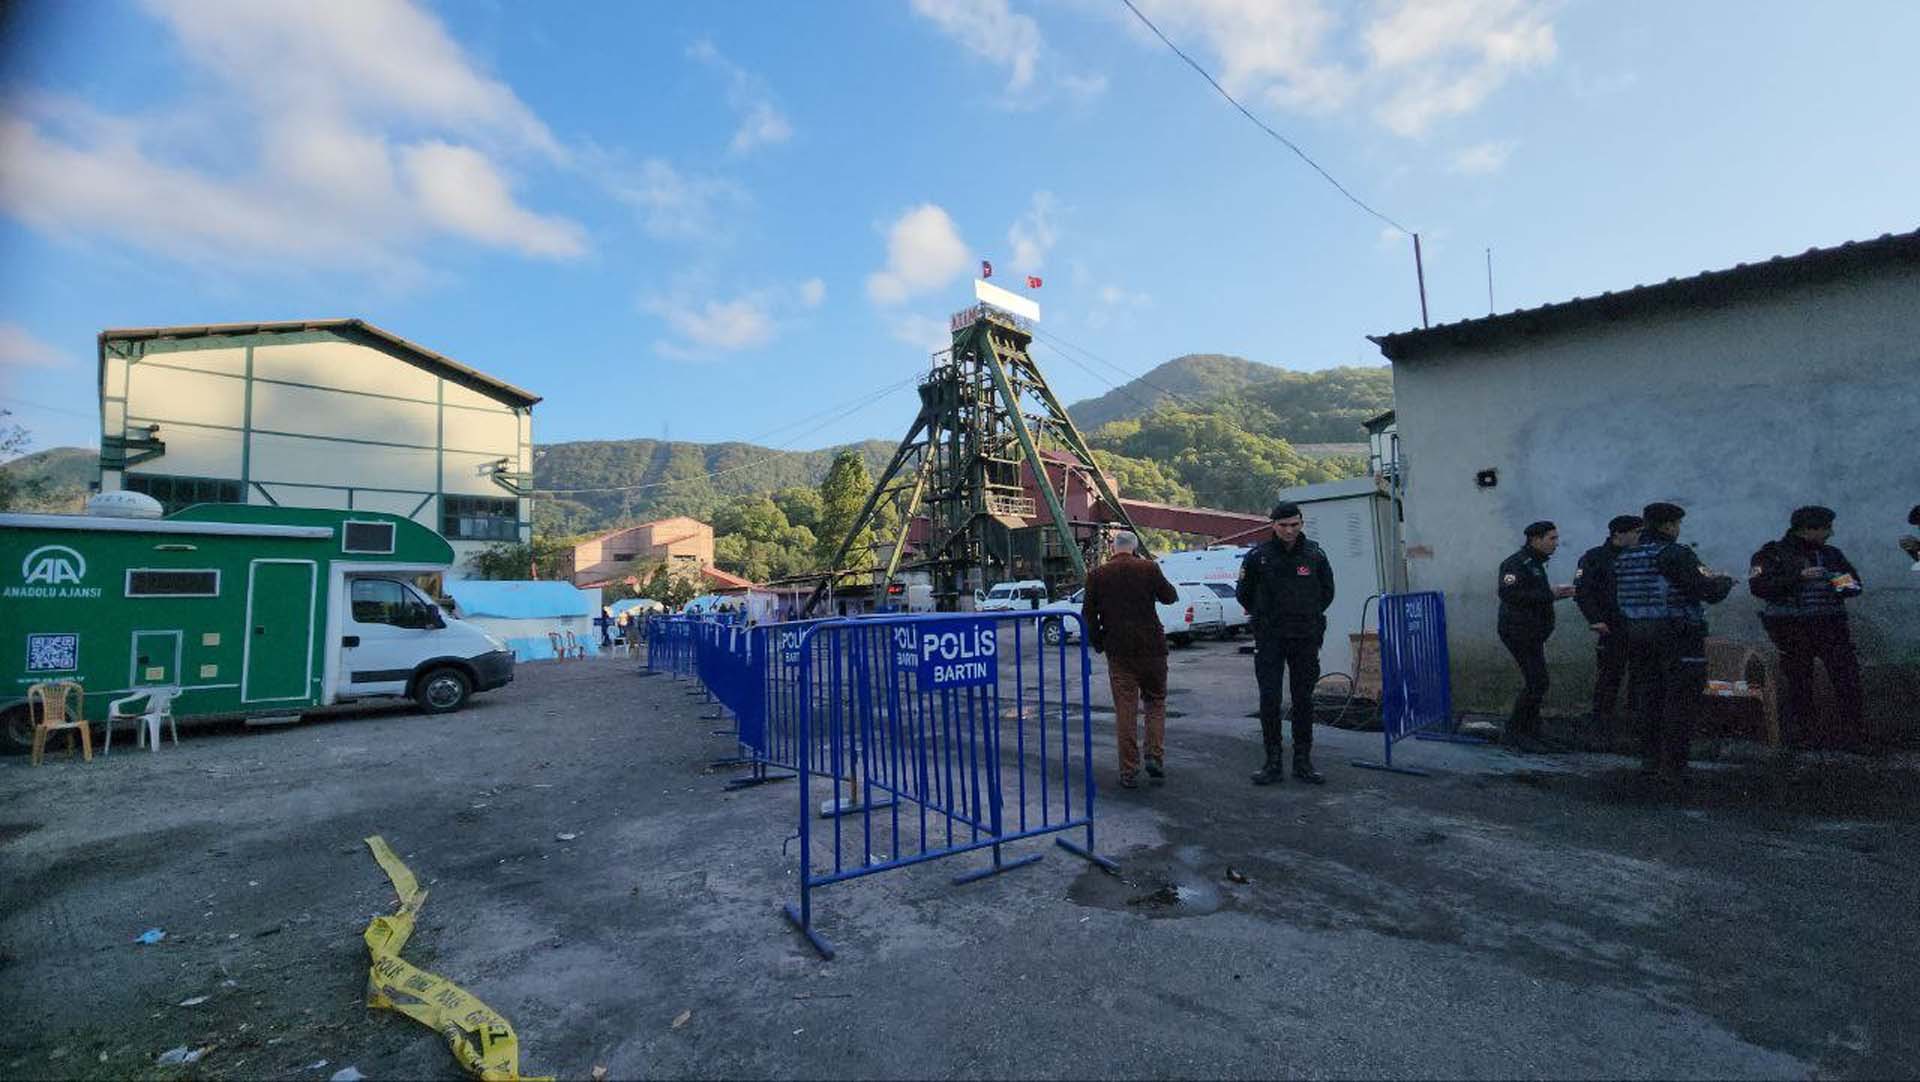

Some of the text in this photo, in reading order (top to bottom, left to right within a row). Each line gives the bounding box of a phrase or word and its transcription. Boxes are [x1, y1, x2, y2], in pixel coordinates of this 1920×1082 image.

[25, 558, 80, 584] AA
[3, 586, 56, 598] ANADOLU
[923, 624, 995, 661] POLİS
[934, 662, 987, 683] BARTIN
